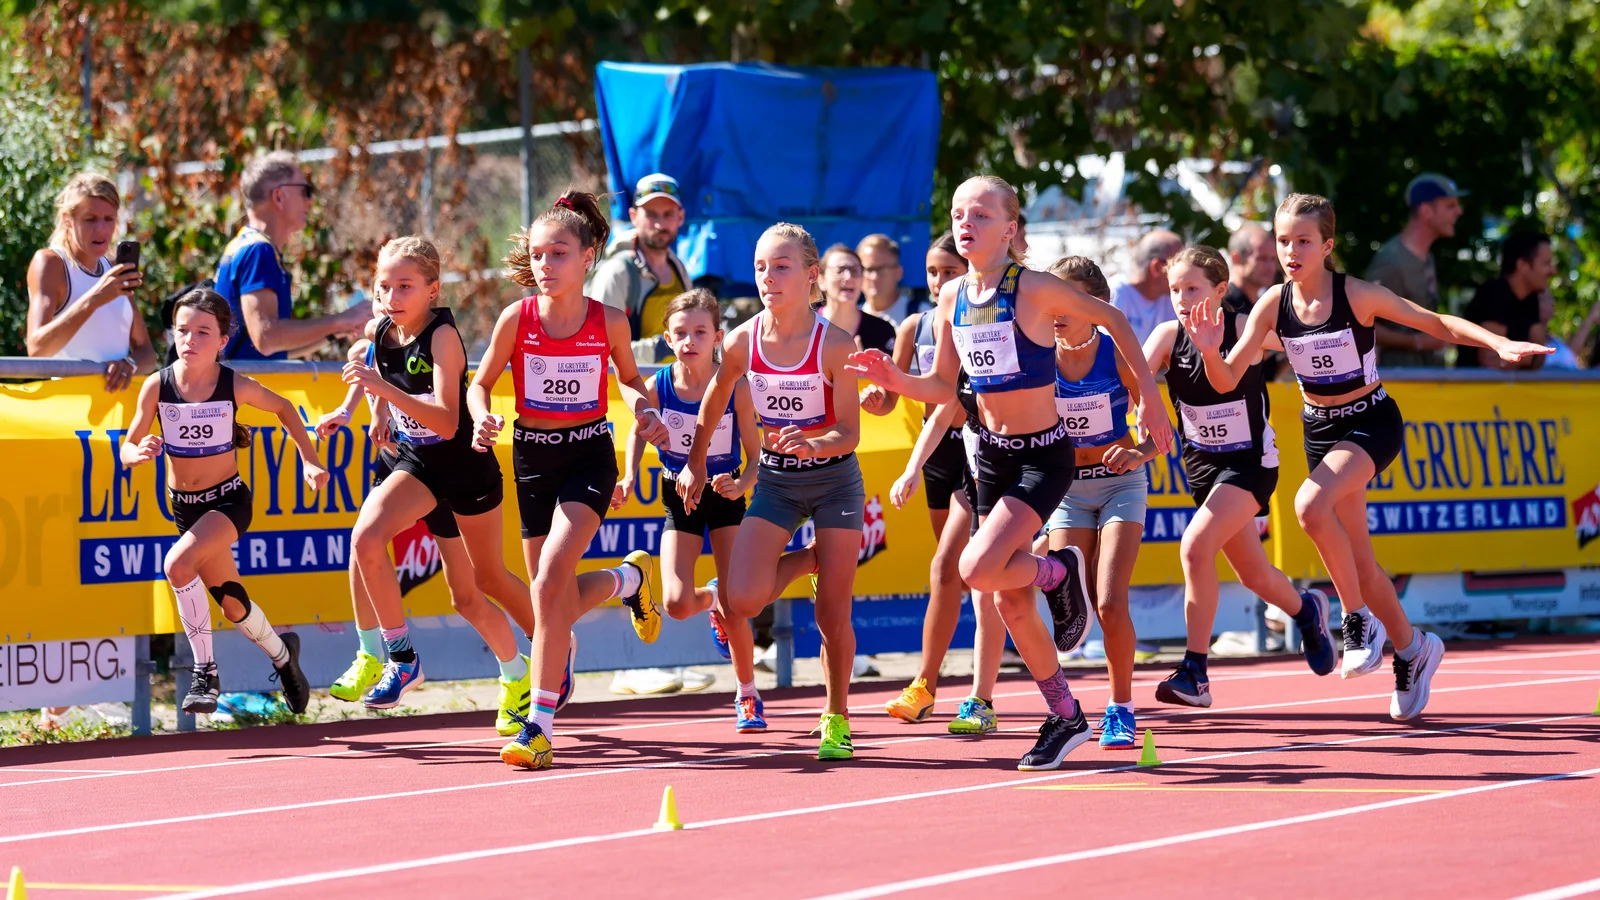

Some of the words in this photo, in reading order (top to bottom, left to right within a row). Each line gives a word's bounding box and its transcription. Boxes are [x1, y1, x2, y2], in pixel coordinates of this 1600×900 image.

[967, 349, 996, 367] 166
[1311, 354, 1334, 369] 58
[542, 378, 581, 395] 280
[766, 395, 804, 412] 206
[1329, 400, 1368, 419] PRO
[178, 424, 214, 440] 239
[524, 432, 563, 445] PRO
[568, 420, 608, 443] NIKE
[989, 436, 1025, 450] PRO
[1030, 423, 1066, 448] NIKE
[1198, 423, 1228, 438] 315
[176, 488, 218, 504] NIKE
[220, 475, 243, 497] PR
[1367, 501, 1560, 532] SWITZERLAND
[1423, 601, 1470, 618] Spengler
[1511, 597, 1558, 611] Montage
